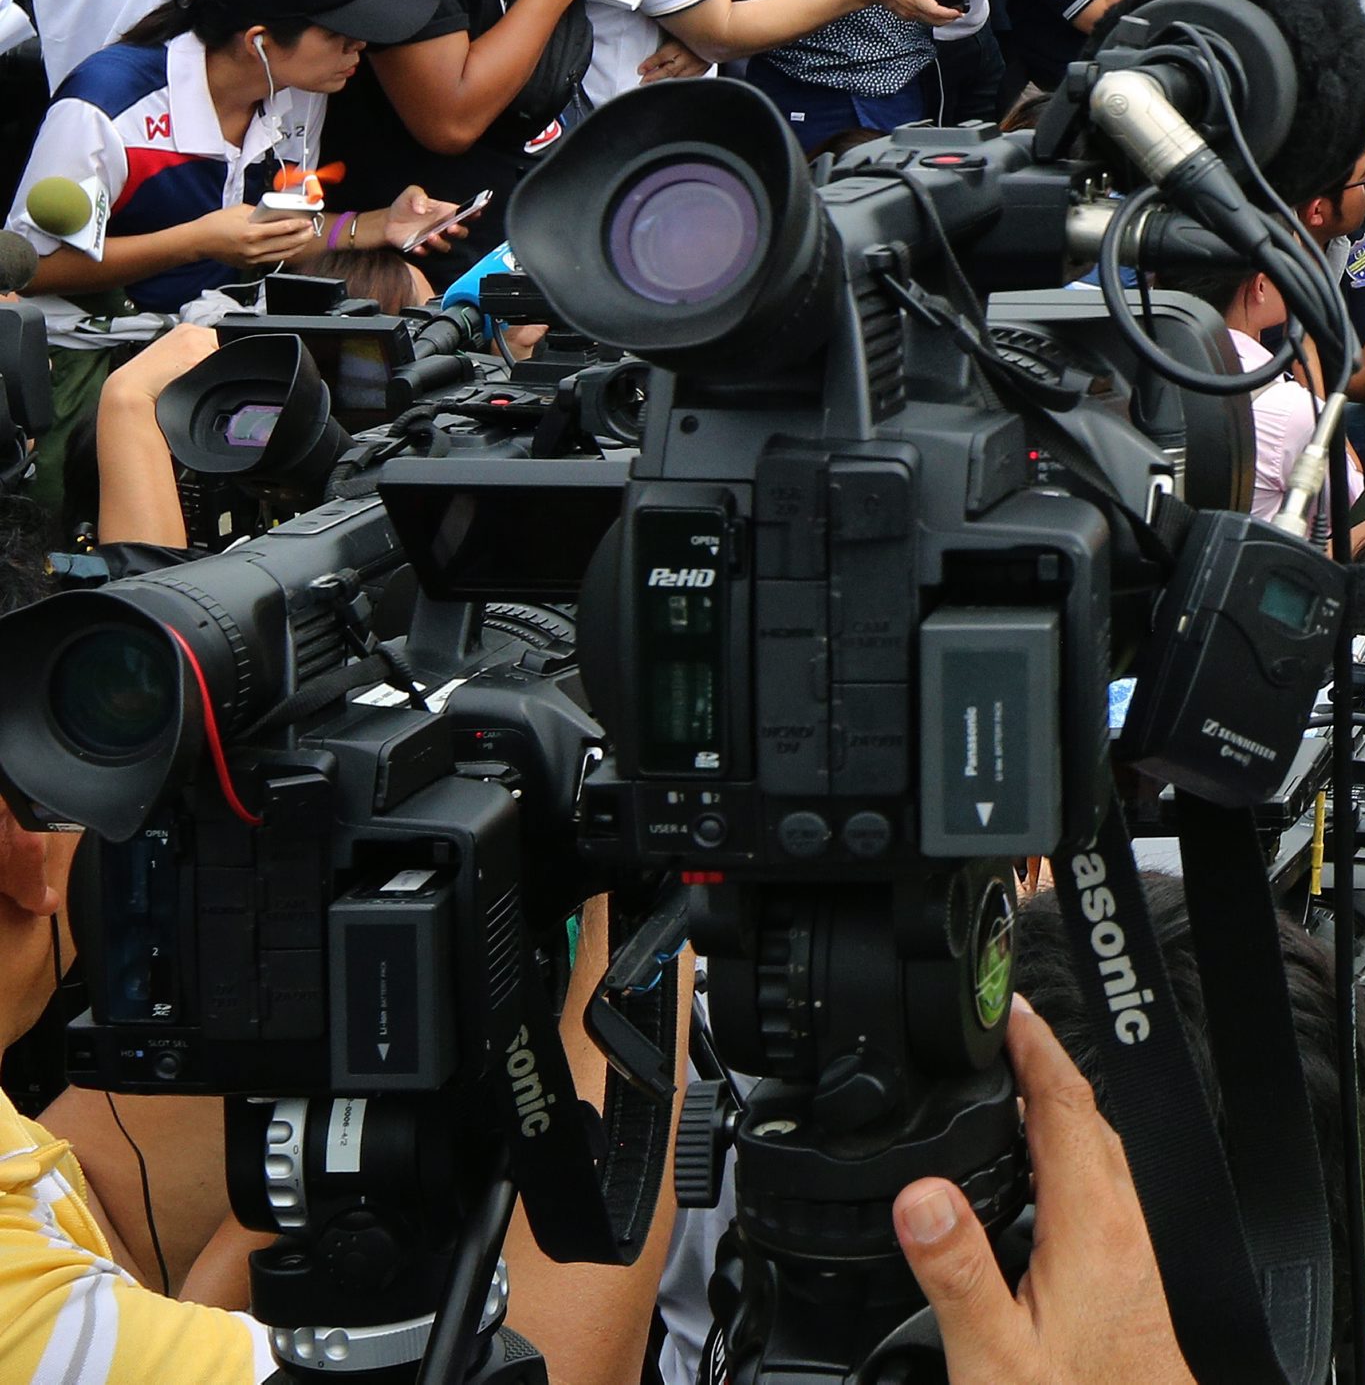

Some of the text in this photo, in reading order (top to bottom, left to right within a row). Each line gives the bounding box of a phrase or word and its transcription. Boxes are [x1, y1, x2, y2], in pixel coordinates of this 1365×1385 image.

[690, 535, 719, 546] OPEN
[648, 568, 716, 587] P2HD
[965, 706, 978, 776] Panasonic
[1217, 727, 1277, 762] SENNHEISER
[145, 830, 169, 838] OPEN
[650, 824, 689, 834] USER 4
[1073, 851, 1150, 1046] asonic
[148, 1040, 170, 1048] SLOT
[506, 1023, 557, 1138] sonic
